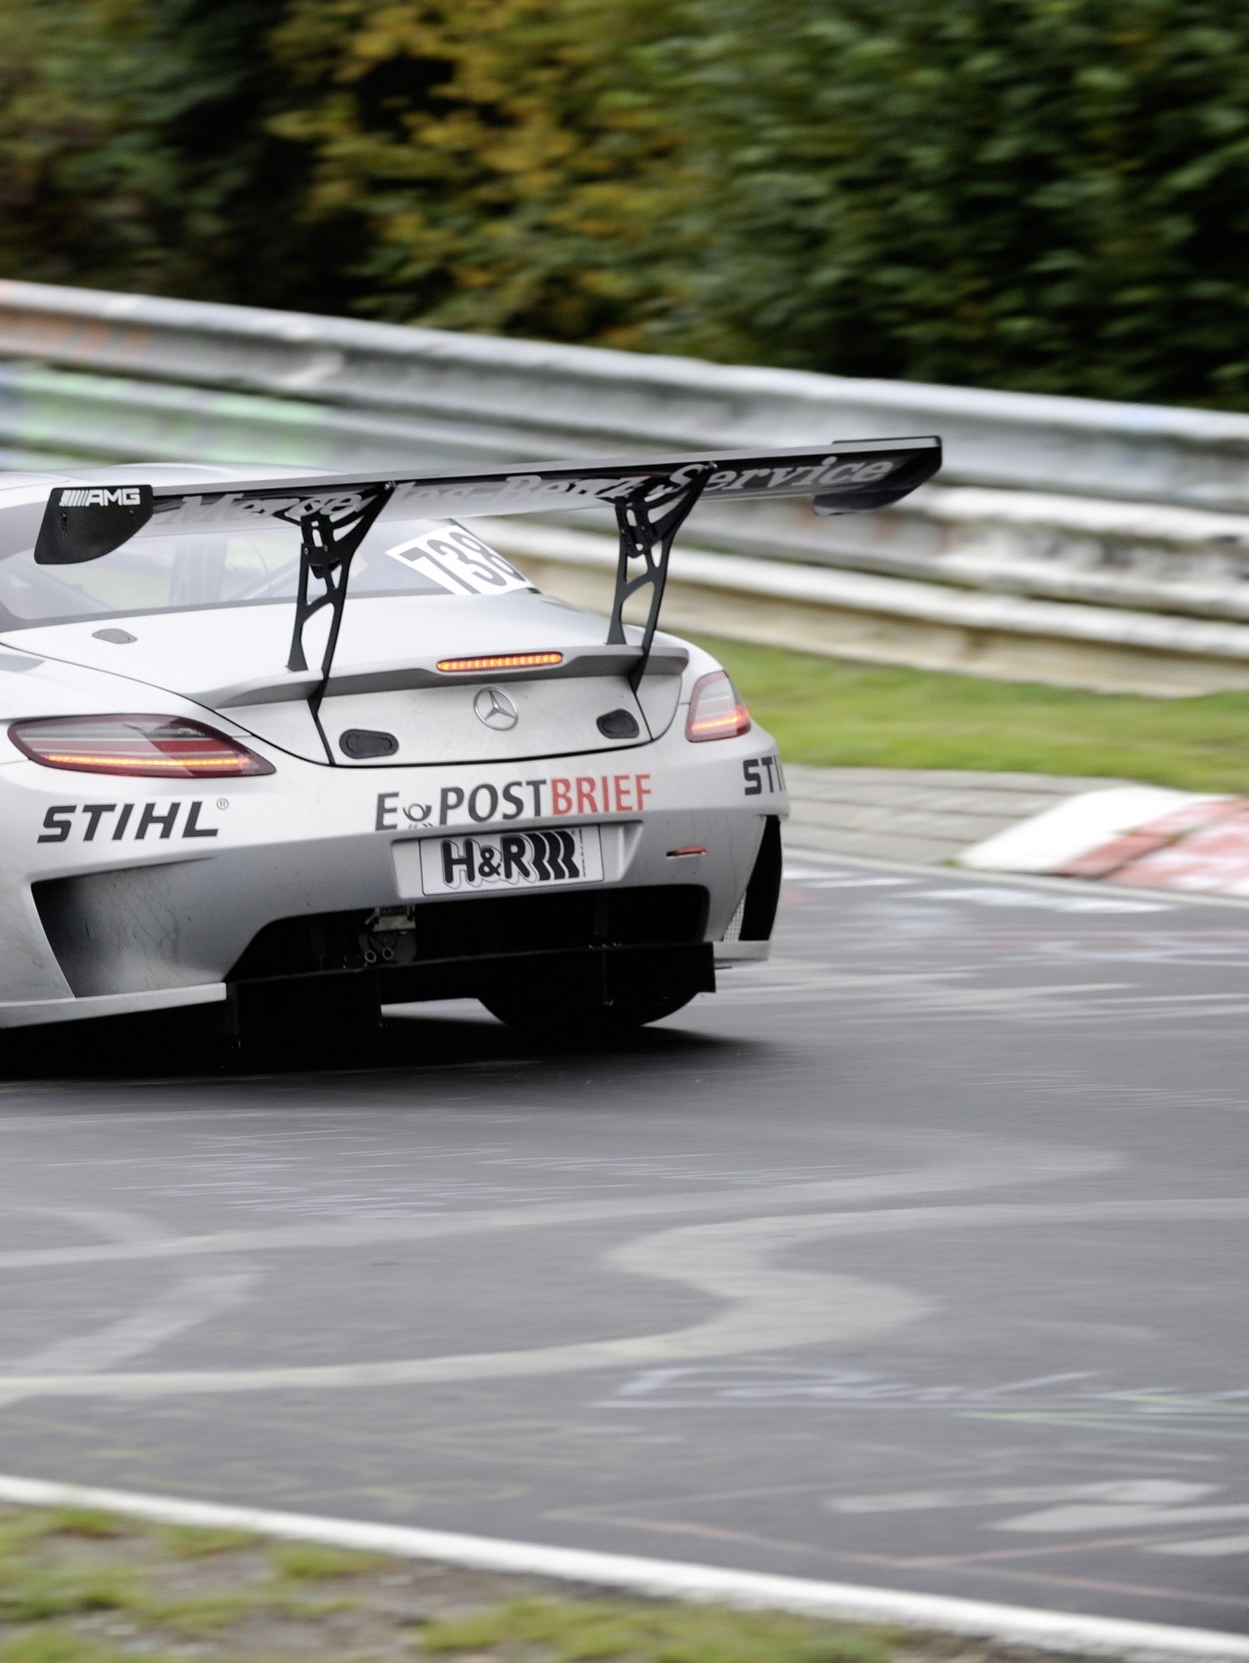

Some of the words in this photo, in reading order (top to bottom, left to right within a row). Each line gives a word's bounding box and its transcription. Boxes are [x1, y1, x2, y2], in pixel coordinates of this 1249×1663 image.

[84, 488, 141, 507] AMG
[399, 531, 527, 595] 738
[37, 800, 219, 844] STIHL
